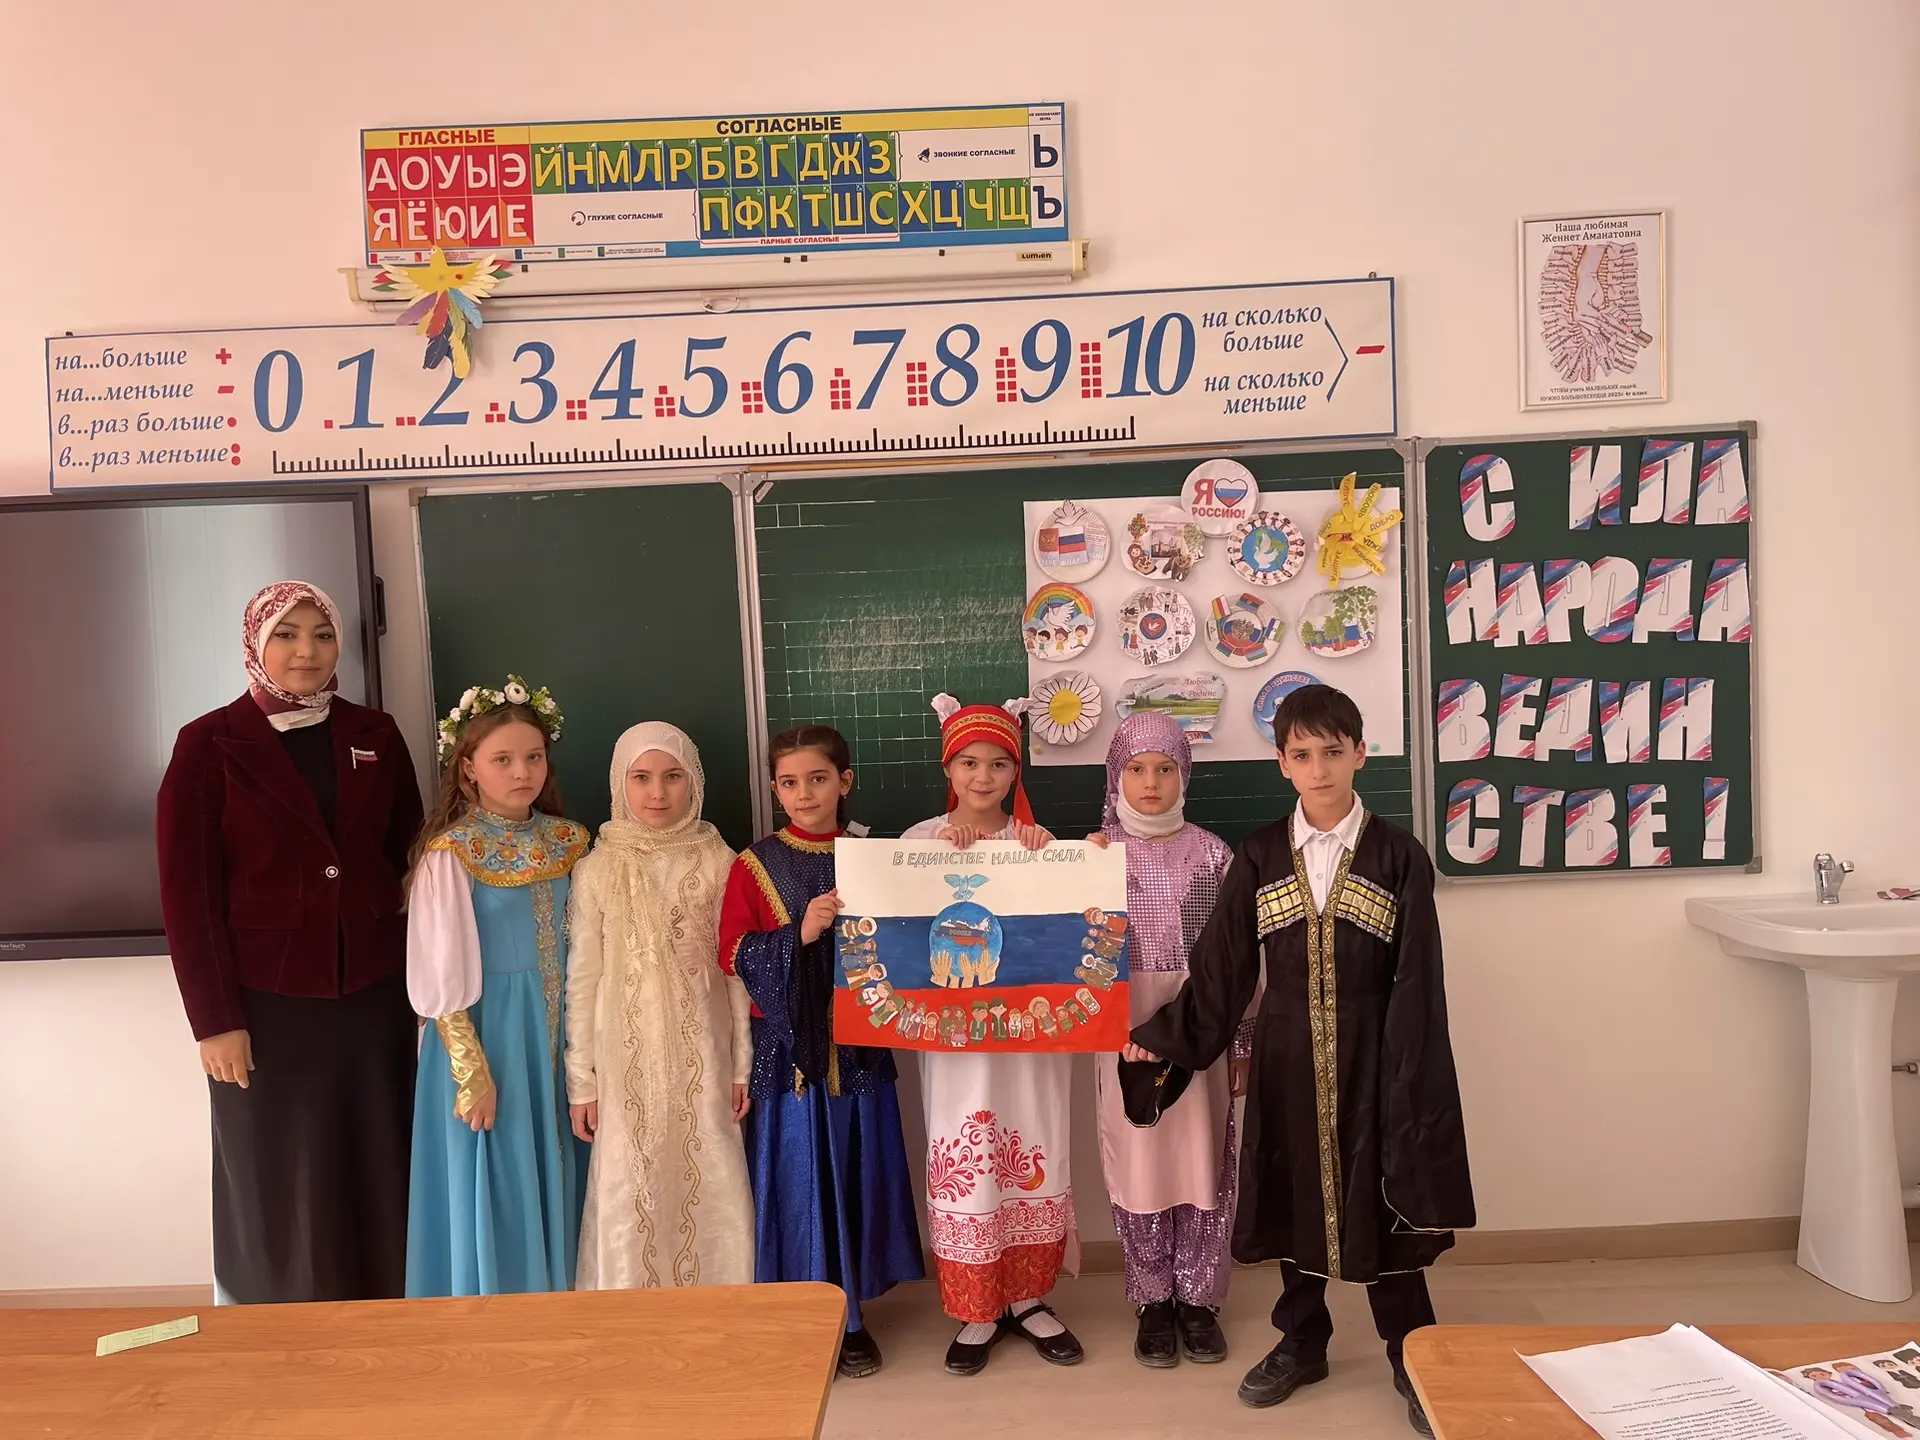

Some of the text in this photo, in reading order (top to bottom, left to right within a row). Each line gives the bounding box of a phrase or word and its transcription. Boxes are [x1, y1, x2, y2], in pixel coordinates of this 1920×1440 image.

[716, 116, 843, 135] СОГЛАСНЫЕ
[398, 129, 496, 147] ГЛАСНЫЕ
[933, 148, 1016, 158] ЗВОНКИЕ СОГЛАСНЫЕ
[587, 212, 663, 222] ГЛУХИЕ СОГЛАСНЫЕ
[1555, 220, 1628, 232] Наша любимая
[760, 235, 840, 245] ПАРНЫЕ СОГЛАСНЫЕ
[1542, 230, 1642, 243] Женнет Аманатовна
[1202, 306, 1322, 328] на сколько
[1223, 330, 1304, 353] больше
[253, 349, 304, 433] 0
[337, 348, 385, 430] 1
[508, 341, 558, 424] 3
[588, 338, 645, 421] 4
[678, 336, 728, 419] 5
[763, 330, 814, 415] 6
[852, 329, 907, 410] 7
[930, 323, 981, 407] 8
[1020, 319, 1072, 403] 9
[1105, 312, 1196, 399] 10
[1204, 370, 1324, 392] на сколько
[1223, 394, 1307, 415] меньше
[136, 411, 224, 433] больше
[136, 445, 229, 465] меньше
[1192, 478, 1215, 506] Я
[1459, 438, 1753, 542] С ИЛА
[1192, 507, 1246, 519] РОССИЮ!
[1369, 514, 1395, 532] ДОБРО
[1444, 555, 1753, 648] НАРОДА
[1437, 673, 1715, 764] ВЕДИН
[892, 848, 1086, 868] В ЕДИНСТВЕ НАША СИЛА
